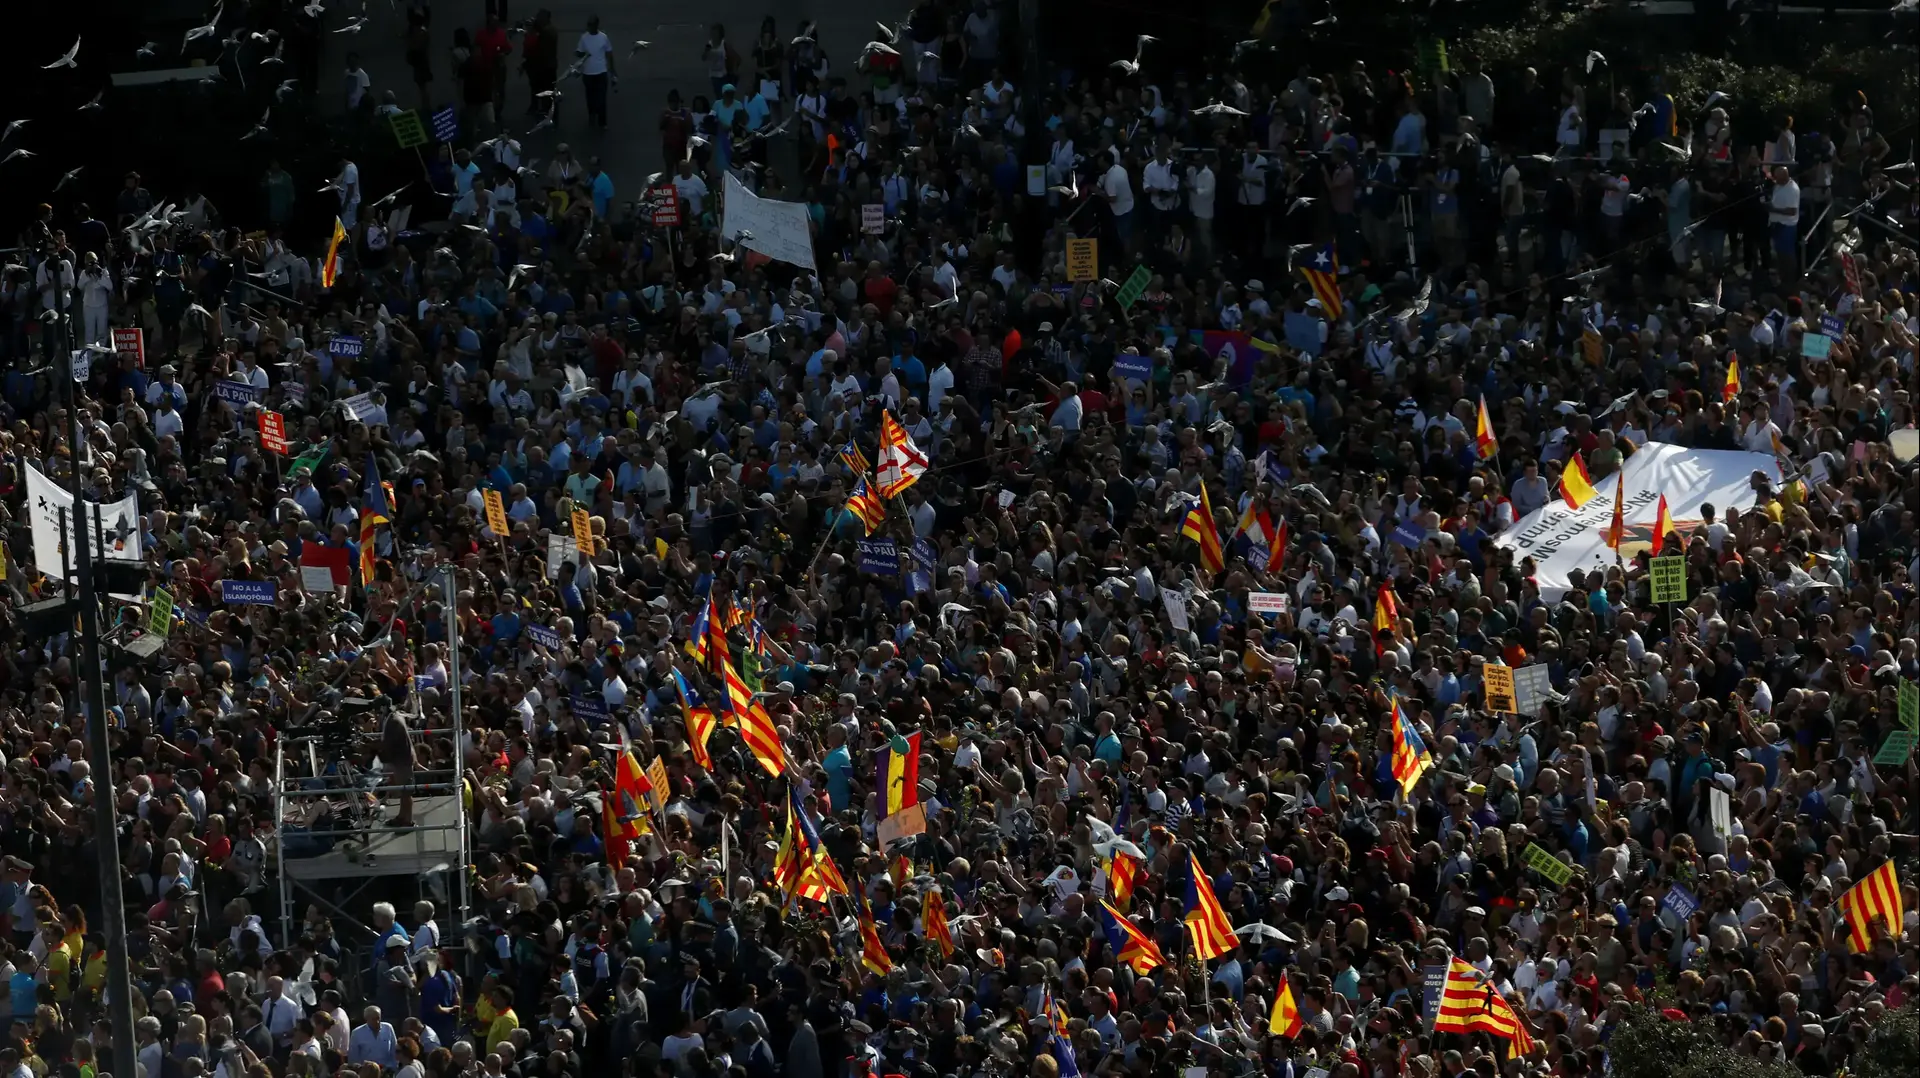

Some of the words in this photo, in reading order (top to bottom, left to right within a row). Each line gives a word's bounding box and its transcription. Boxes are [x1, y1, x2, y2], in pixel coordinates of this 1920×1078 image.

[329, 342, 340, 353] LA
[216, 386, 230, 398] LA
[232, 390, 253, 402] PAU
[857, 543, 873, 554] LA
[873, 546, 896, 556] PAU
[1652, 559, 1682, 568] IMAGINA
[1654, 569, 1664, 577] UN
[1656, 576, 1669, 584] QUE
[1658, 592, 1680, 600] ARMES
[528, 630, 541, 642] LA
[541, 634, 559, 650] PAU
[1664, 890, 1677, 907] LA
[1674, 899, 1691, 918] PAU
